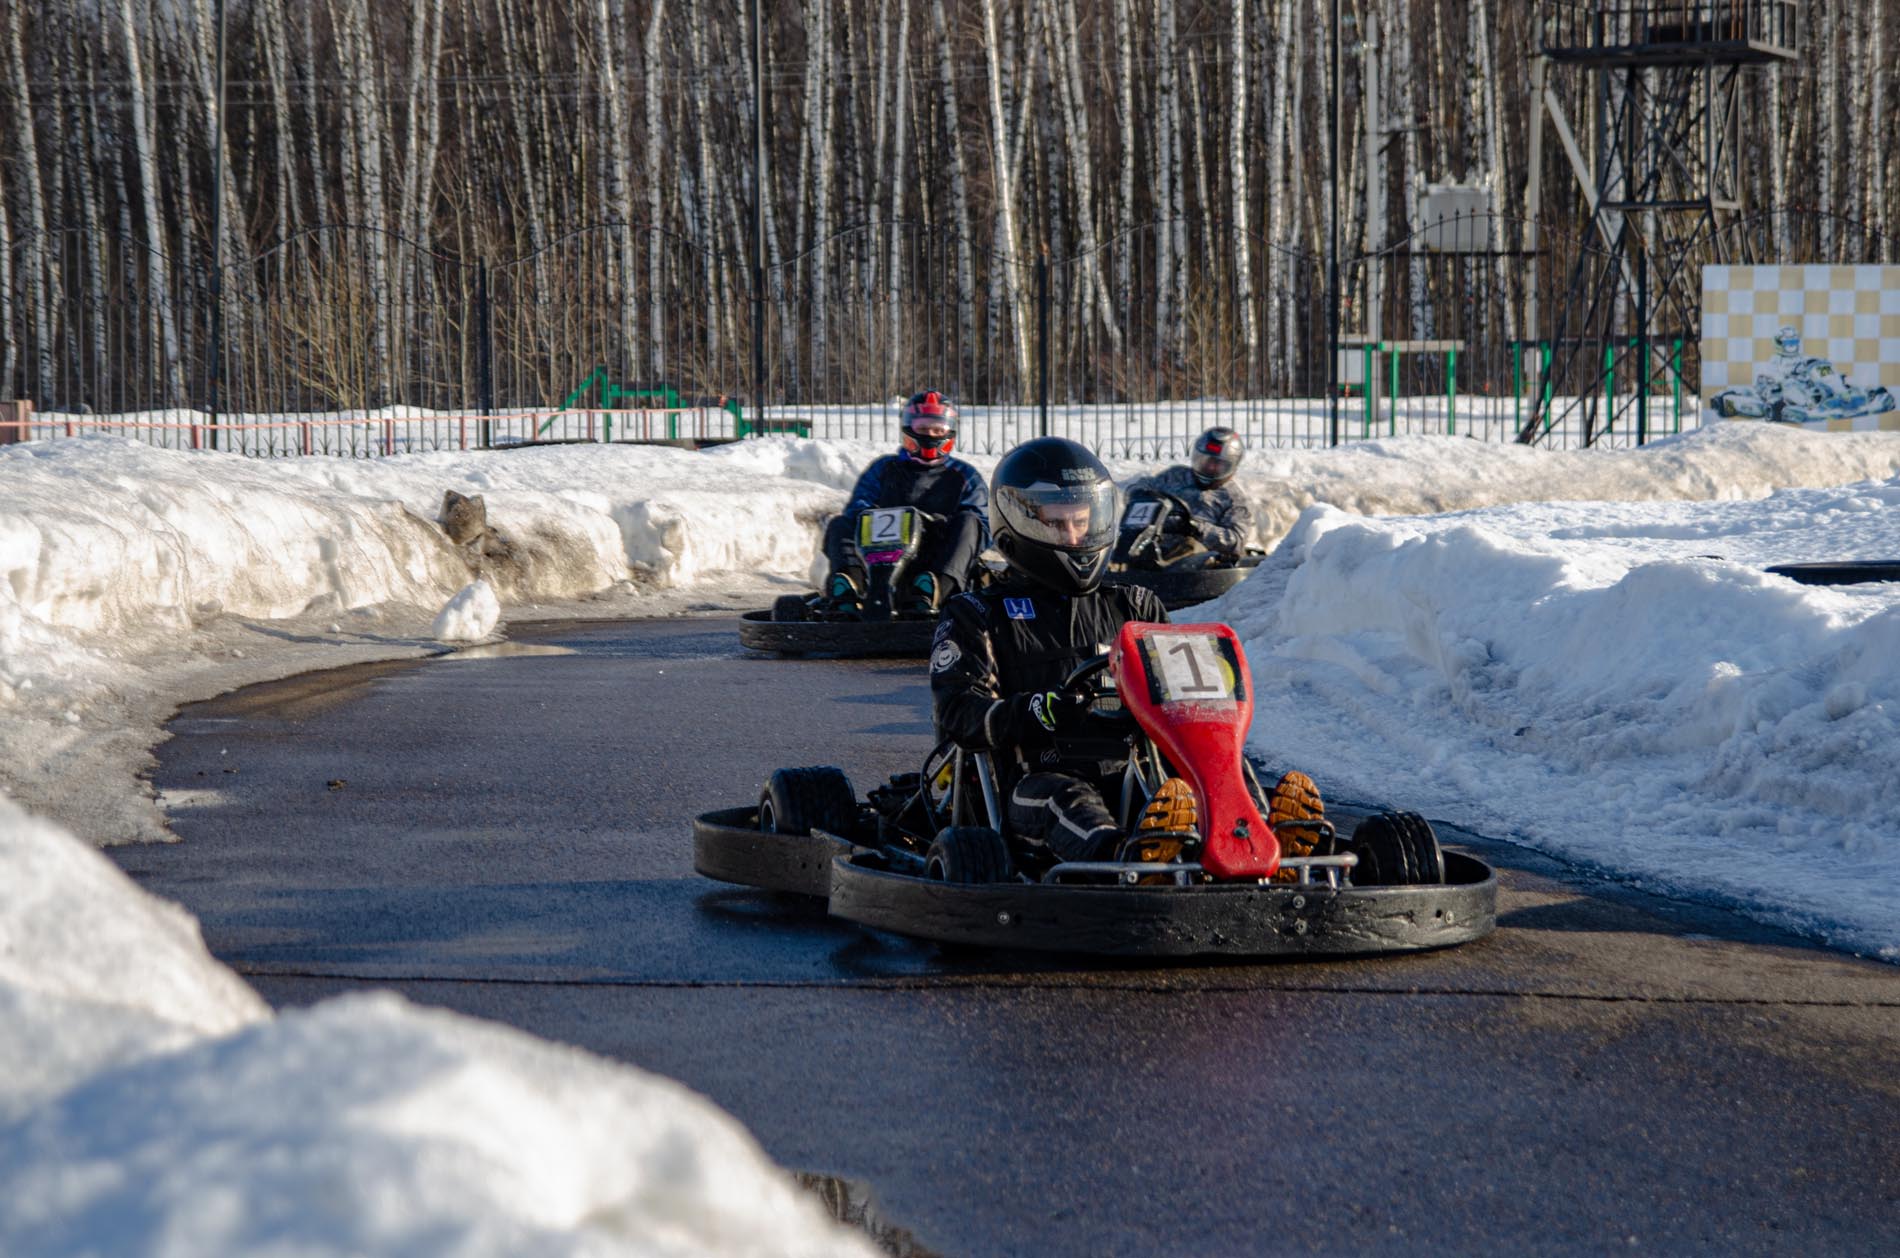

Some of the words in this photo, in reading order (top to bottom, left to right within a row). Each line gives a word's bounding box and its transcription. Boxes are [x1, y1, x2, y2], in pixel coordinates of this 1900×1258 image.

[877, 513, 898, 538] 2
[1131, 505, 1149, 521] 4
[1168, 641, 1219, 693] 1
